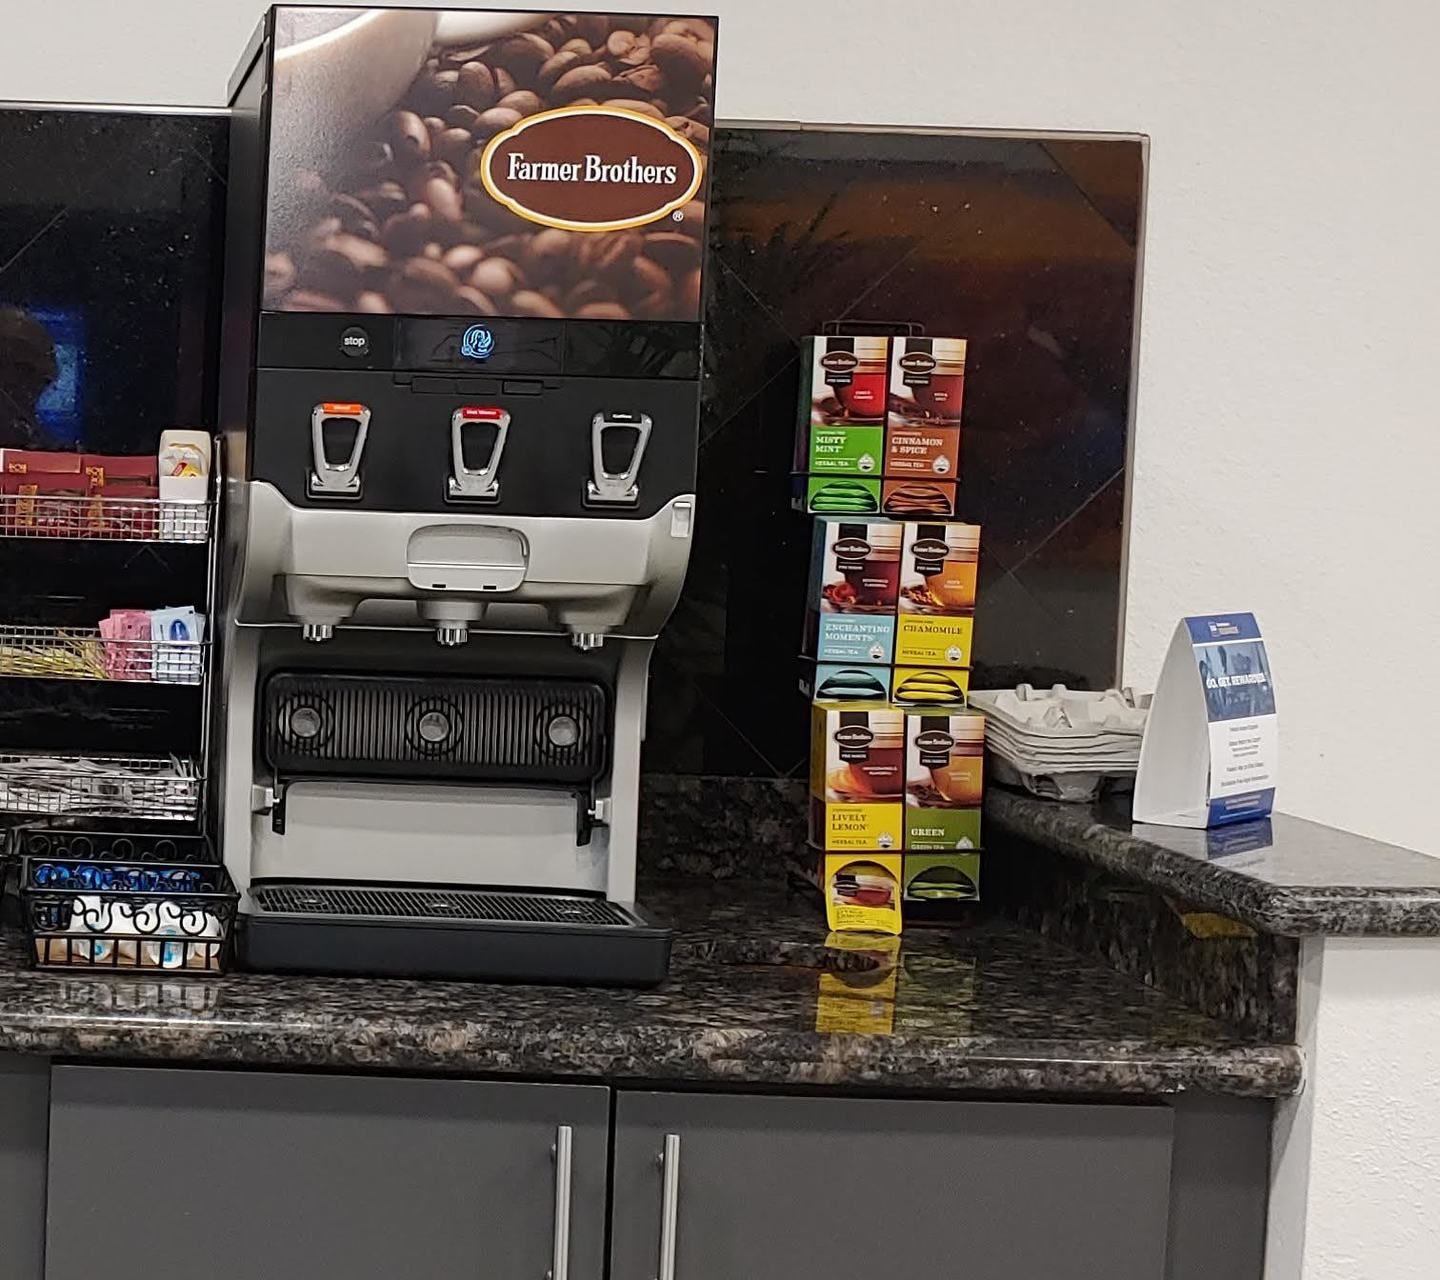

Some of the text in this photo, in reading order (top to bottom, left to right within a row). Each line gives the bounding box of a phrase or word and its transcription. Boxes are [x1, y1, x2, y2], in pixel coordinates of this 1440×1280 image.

[507, 152, 677, 184] Farmer Brothers
[344, 336, 365, 347] stop
[816, 436, 847, 444] MISTY
[891, 436, 944, 446] CINNAMON
[899, 446, 928, 455] SPICE
[825, 623, 890, 633] ENCHANTING
[903, 624, 962, 635] CHAMOMILE
[825, 632, 873, 642] MOMENTS
[832, 814, 867, 822] LIVELY
[832, 823, 866, 831] LEMON
[911, 828, 945, 837] GREEN
